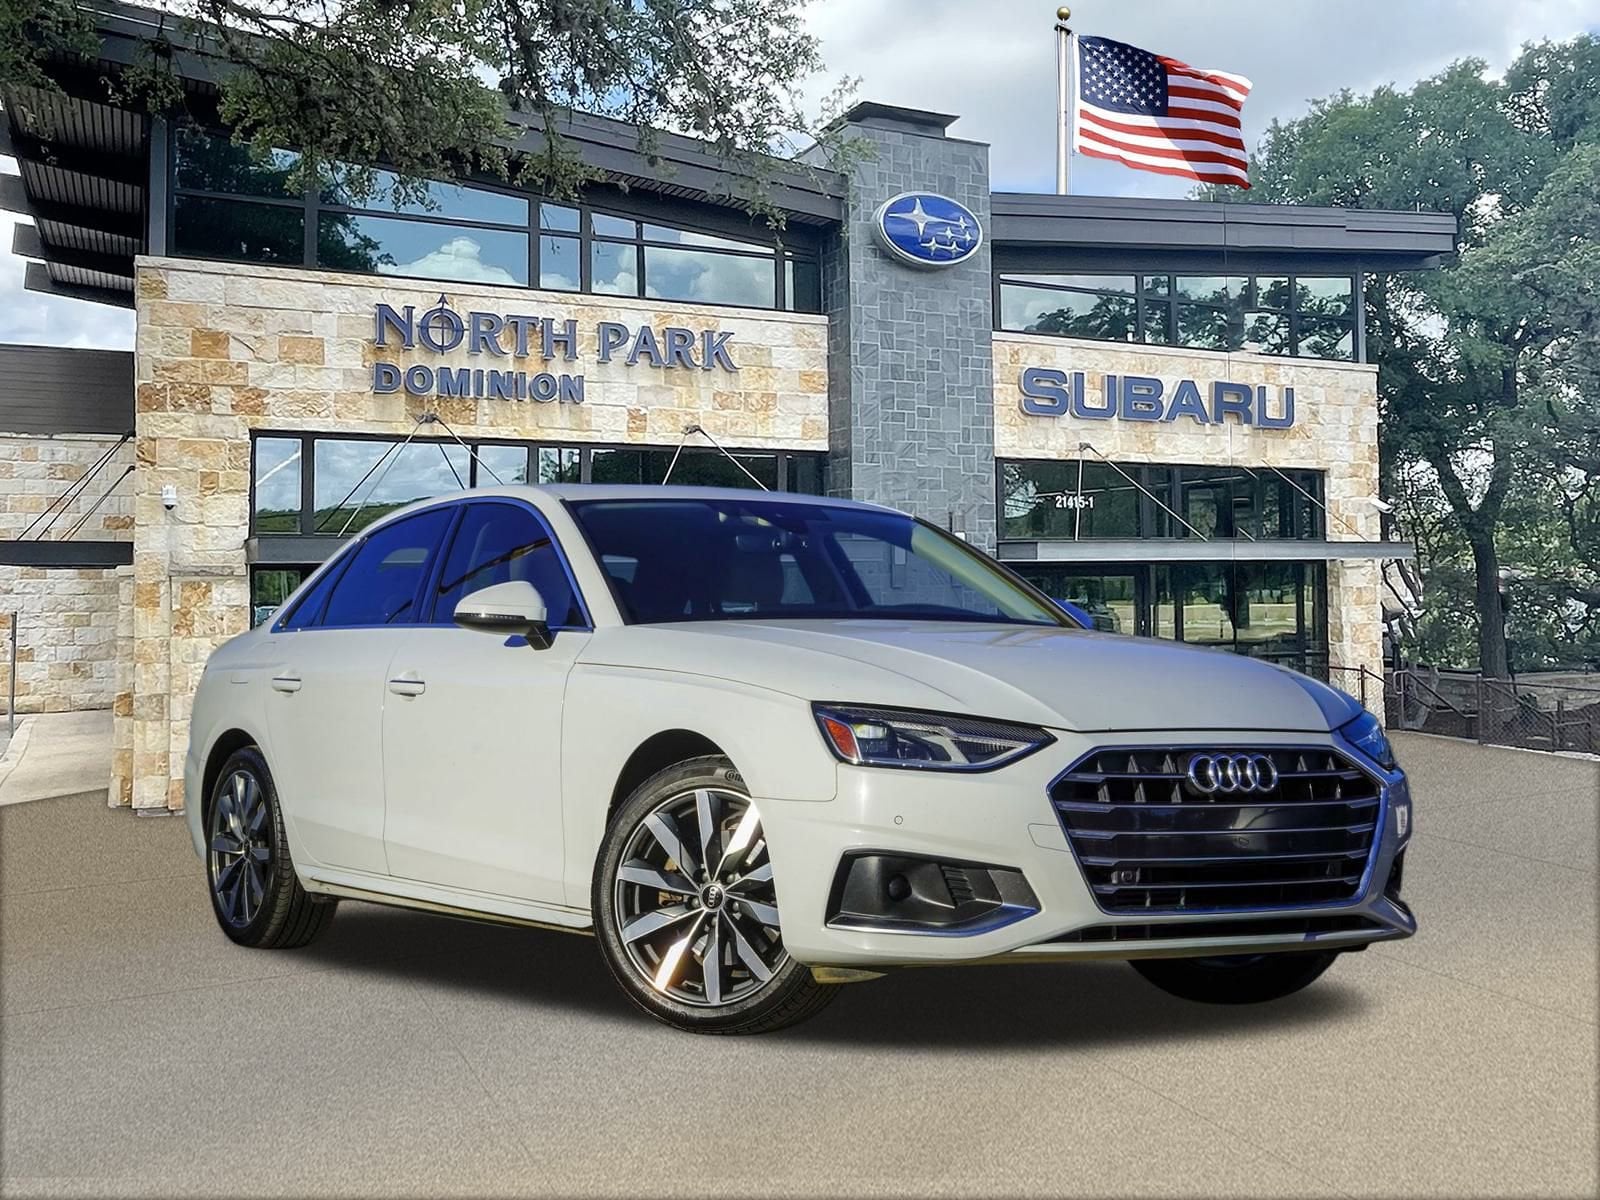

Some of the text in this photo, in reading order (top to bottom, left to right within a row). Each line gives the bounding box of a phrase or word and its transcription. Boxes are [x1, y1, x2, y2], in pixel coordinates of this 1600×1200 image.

[374, 300, 741, 372] NORTH PARK
[373, 362, 585, 404] DOMINION
[1019, 367, 1295, 430] SUBARU
